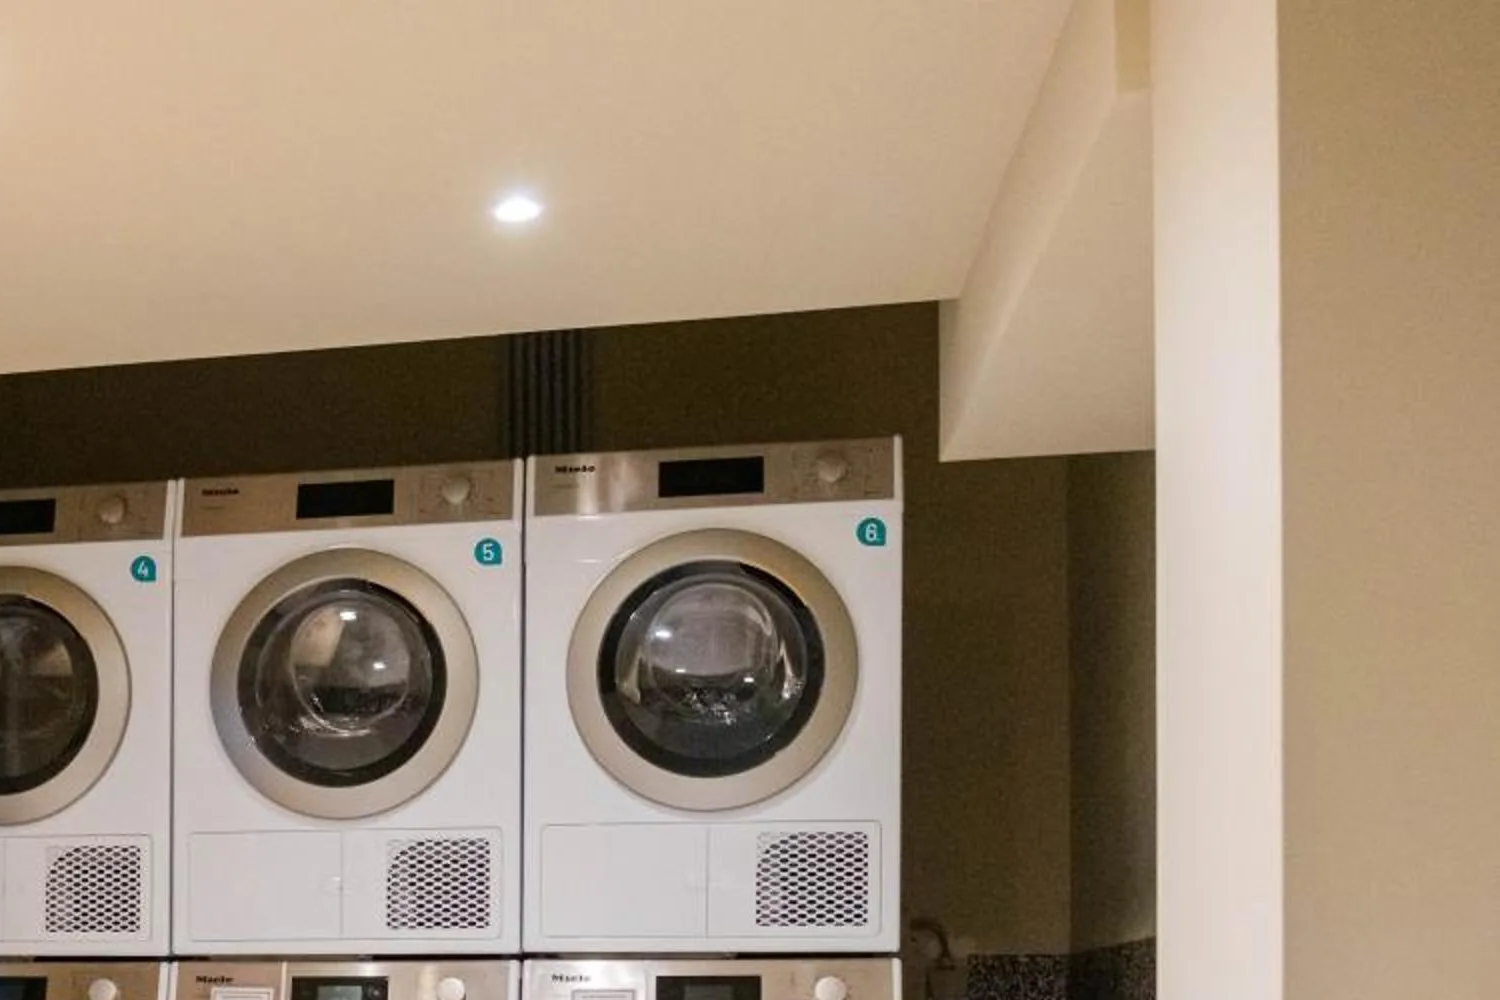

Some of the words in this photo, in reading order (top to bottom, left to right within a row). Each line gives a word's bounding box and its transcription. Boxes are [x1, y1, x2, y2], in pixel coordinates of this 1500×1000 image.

[866, 522, 877, 541] 6
[483, 542, 494, 561] 5
[138, 559, 150, 577] 4
